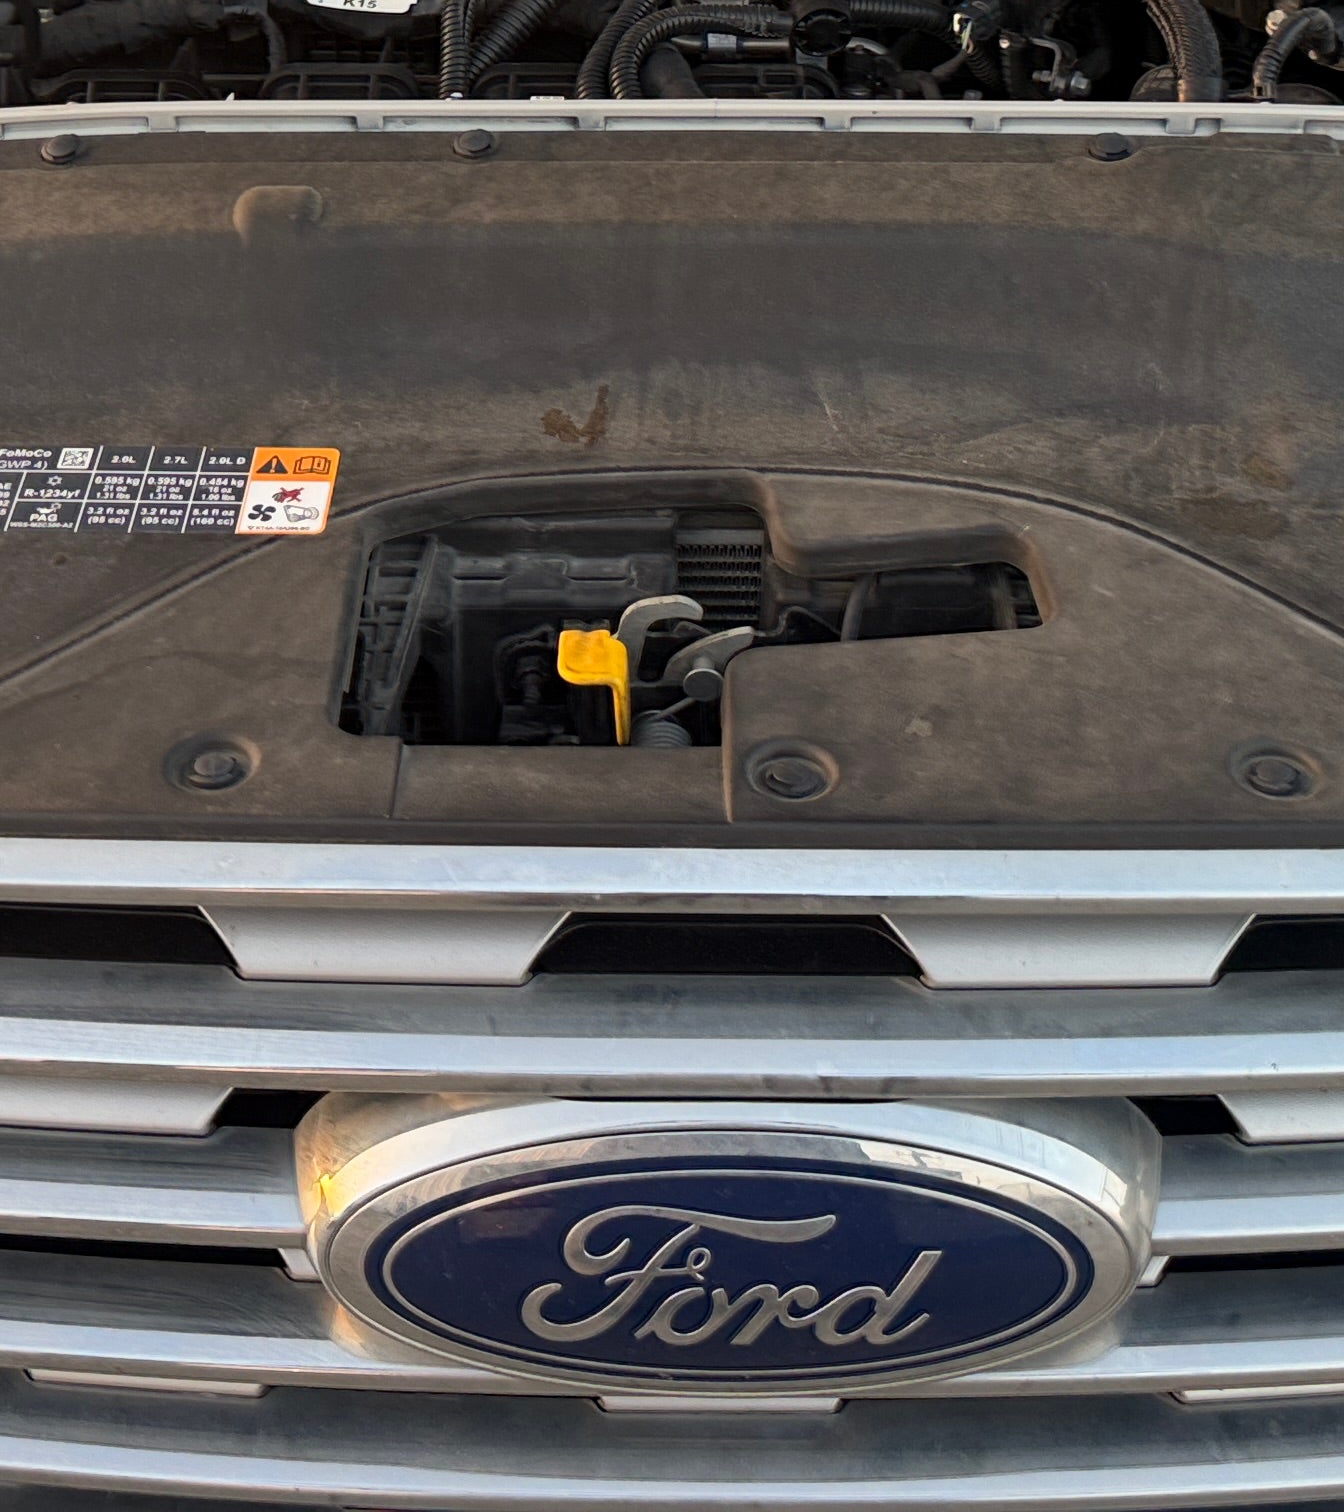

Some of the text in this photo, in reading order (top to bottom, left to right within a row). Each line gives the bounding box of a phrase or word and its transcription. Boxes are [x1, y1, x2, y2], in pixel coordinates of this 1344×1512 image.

[33, 460, 48, 470] 4)
[163, 456, 189, 465] 2.7L
[236, 456, 246, 465] D
[125, 476, 141, 487] kg
[178, 477, 193, 487] kg
[230, 478, 245, 488] kg
[24, 489, 80, 499] R-1234yf
[29, 513, 58, 522] PAG
[520, 1204, 943, 1347] Ford
